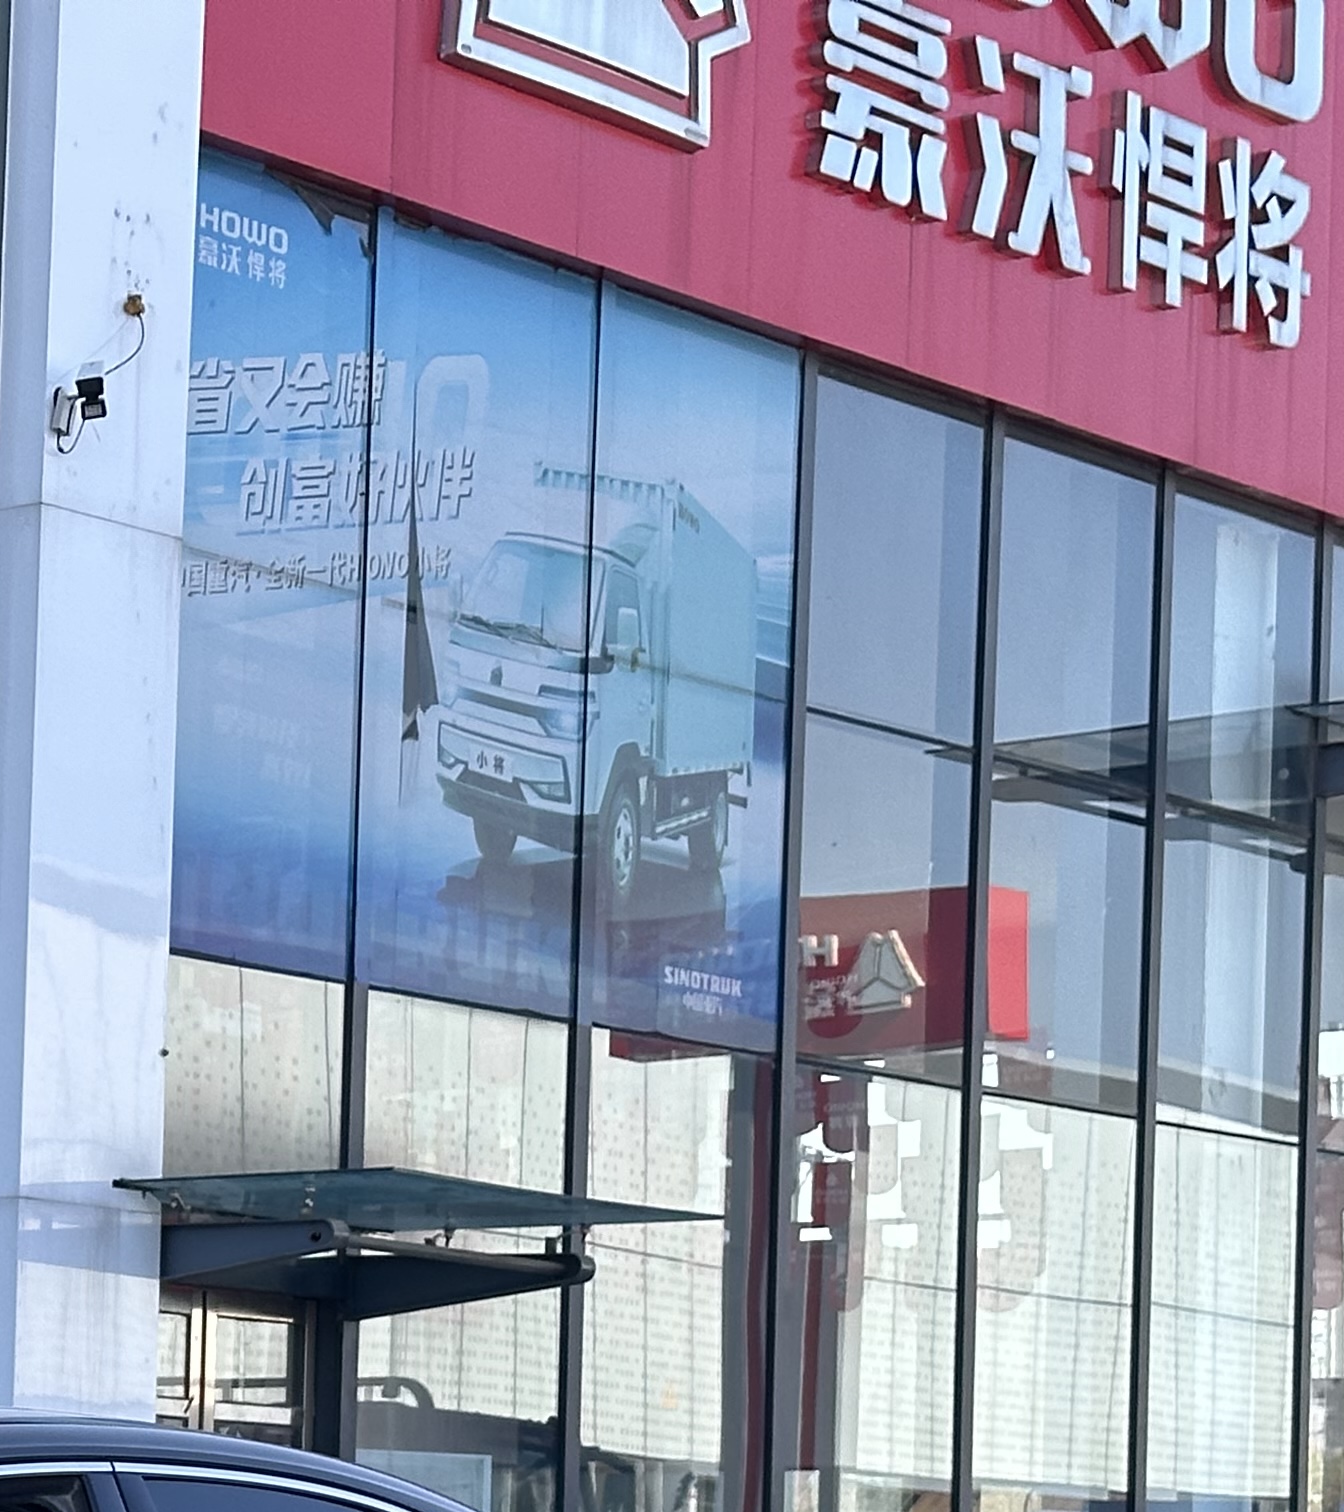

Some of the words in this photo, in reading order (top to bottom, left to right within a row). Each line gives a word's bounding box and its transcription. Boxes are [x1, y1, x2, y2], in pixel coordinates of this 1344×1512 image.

[817, 0, 1311, 349] 豪沃悍将
[200, 203, 288, 255] HOWO
[198, 235, 287, 289] 豪沃悍将
[238, 447, 475, 533] 创富好伙伴
[664, 966, 742, 997] SINOTRUK
